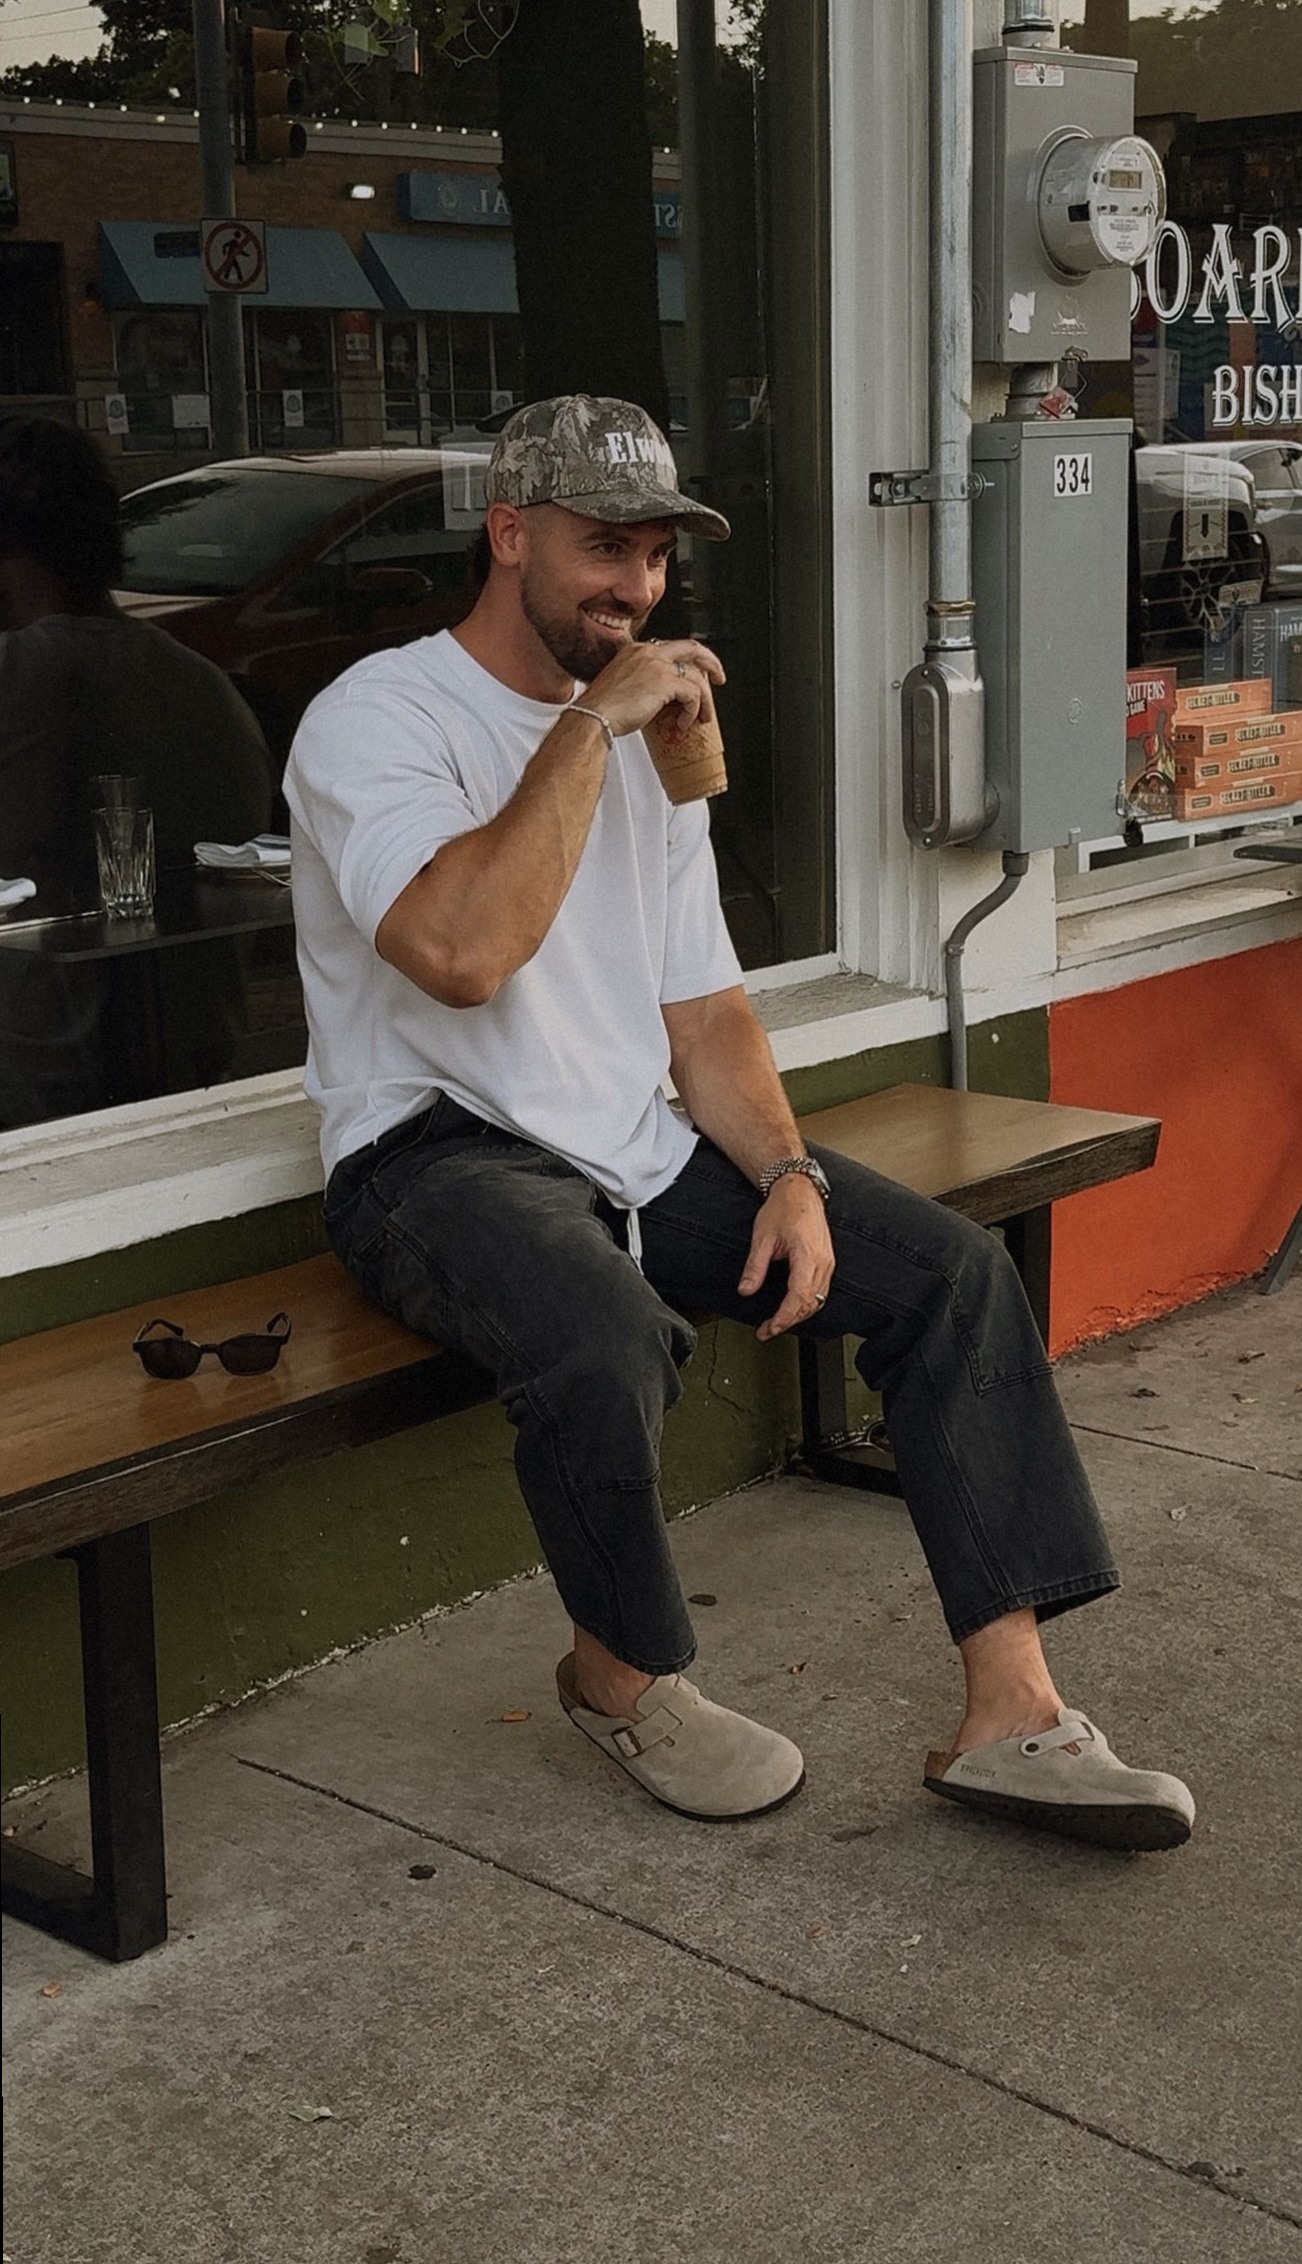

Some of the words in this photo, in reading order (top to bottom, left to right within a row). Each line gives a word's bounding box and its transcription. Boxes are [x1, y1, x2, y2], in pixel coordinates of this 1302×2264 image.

[1130, 219, 1302, 333] OAR
[1056, 457, 1090, 493] 334
[1126, 680, 1165, 702] KITTENS
